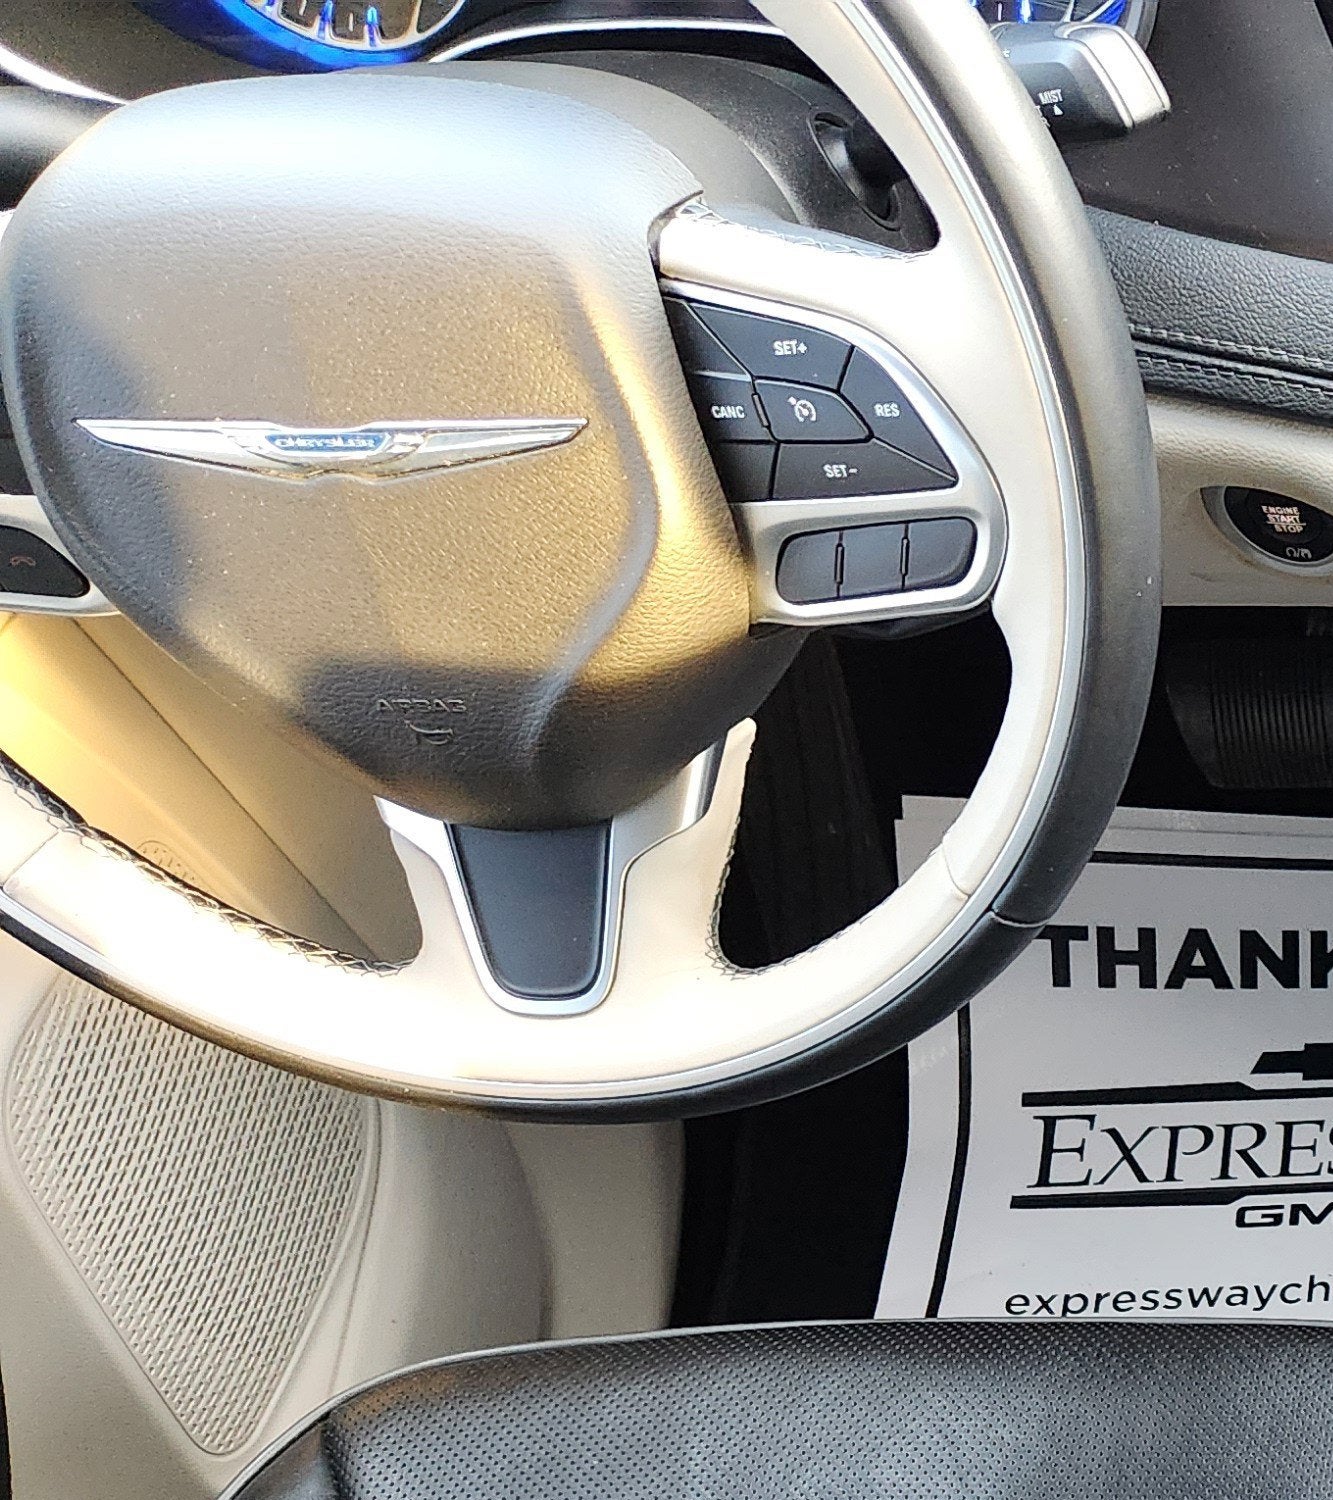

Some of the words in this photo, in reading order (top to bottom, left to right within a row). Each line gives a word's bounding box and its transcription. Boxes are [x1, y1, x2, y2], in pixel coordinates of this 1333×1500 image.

[711, 405, 745, 420] CANC
[874, 403, 900, 418] RES
[274, 434, 376, 448] CHRYSLER
[1261, 505, 1300, 515] ENGINE
[1267, 514, 1300, 523] START
[1274, 524, 1304, 533] STOP
